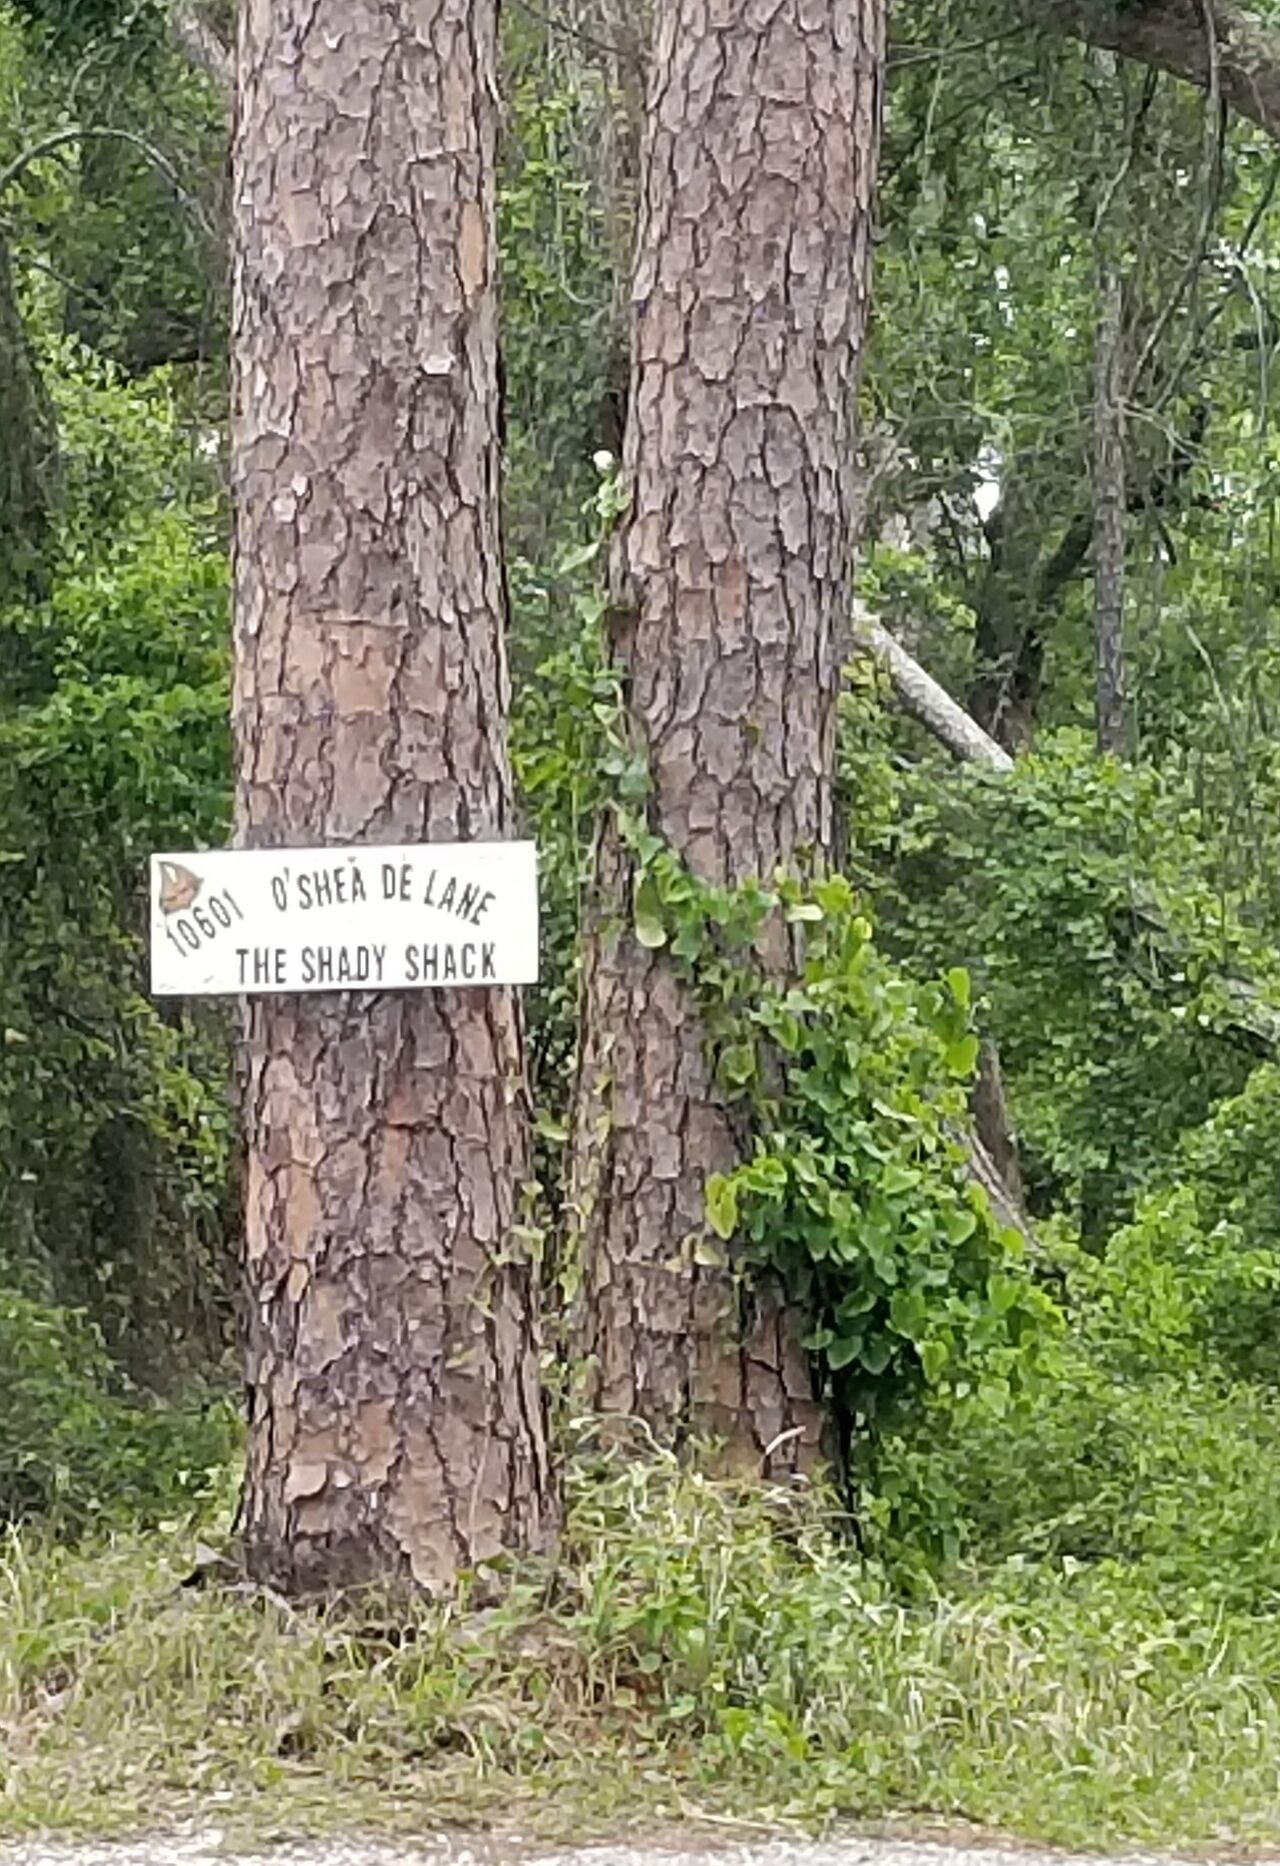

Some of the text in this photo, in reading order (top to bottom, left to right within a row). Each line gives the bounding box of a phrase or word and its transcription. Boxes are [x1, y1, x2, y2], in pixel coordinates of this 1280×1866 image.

[166, 887, 244, 958] 10601
[381, 863, 412, 902] DE
[424, 869, 496, 926] LANE
[235, 942, 496, 985] THE SHADY SHACK
